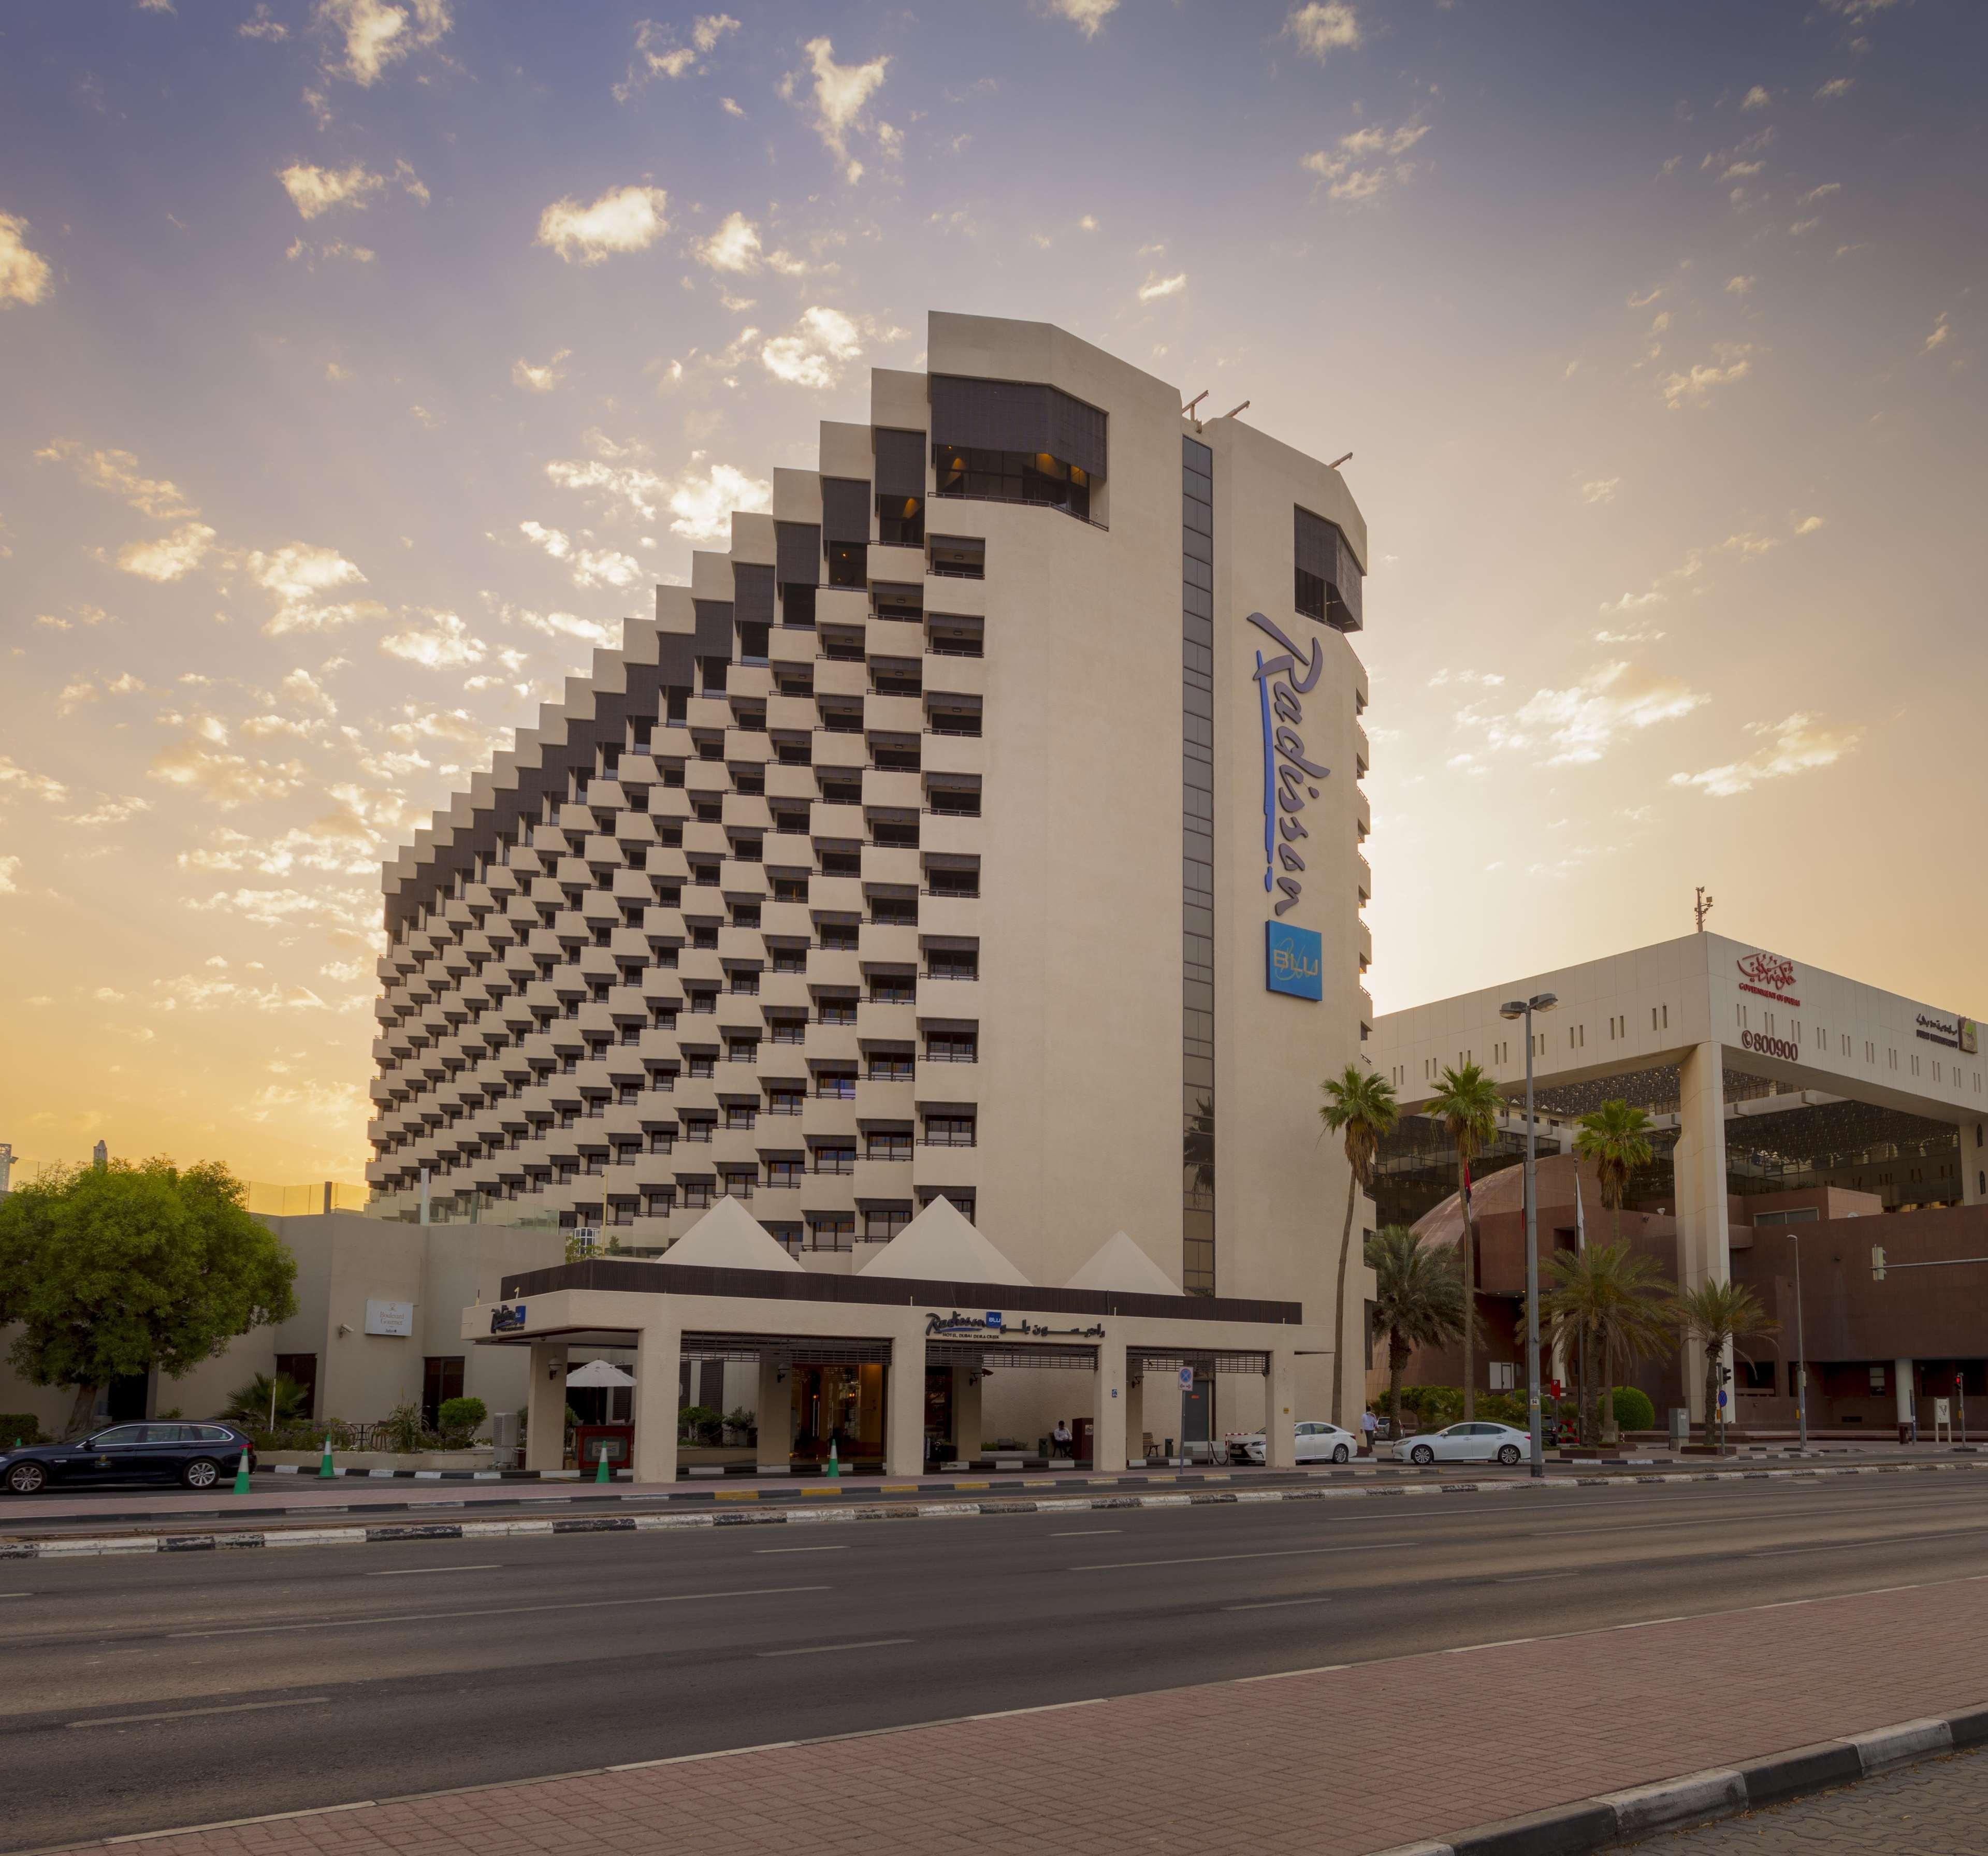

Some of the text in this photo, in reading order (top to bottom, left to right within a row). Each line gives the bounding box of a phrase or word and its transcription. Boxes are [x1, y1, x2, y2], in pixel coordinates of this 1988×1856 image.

[1247, 612, 1330, 917] Radisson
[1273, 949, 1318, 976] BLU
[1739, 982, 1801, 1007] GOVERNMENT OF DUBAI
[1753, 1033, 1798, 1062] 800900
[925, 1311, 986, 1336] Radisson
